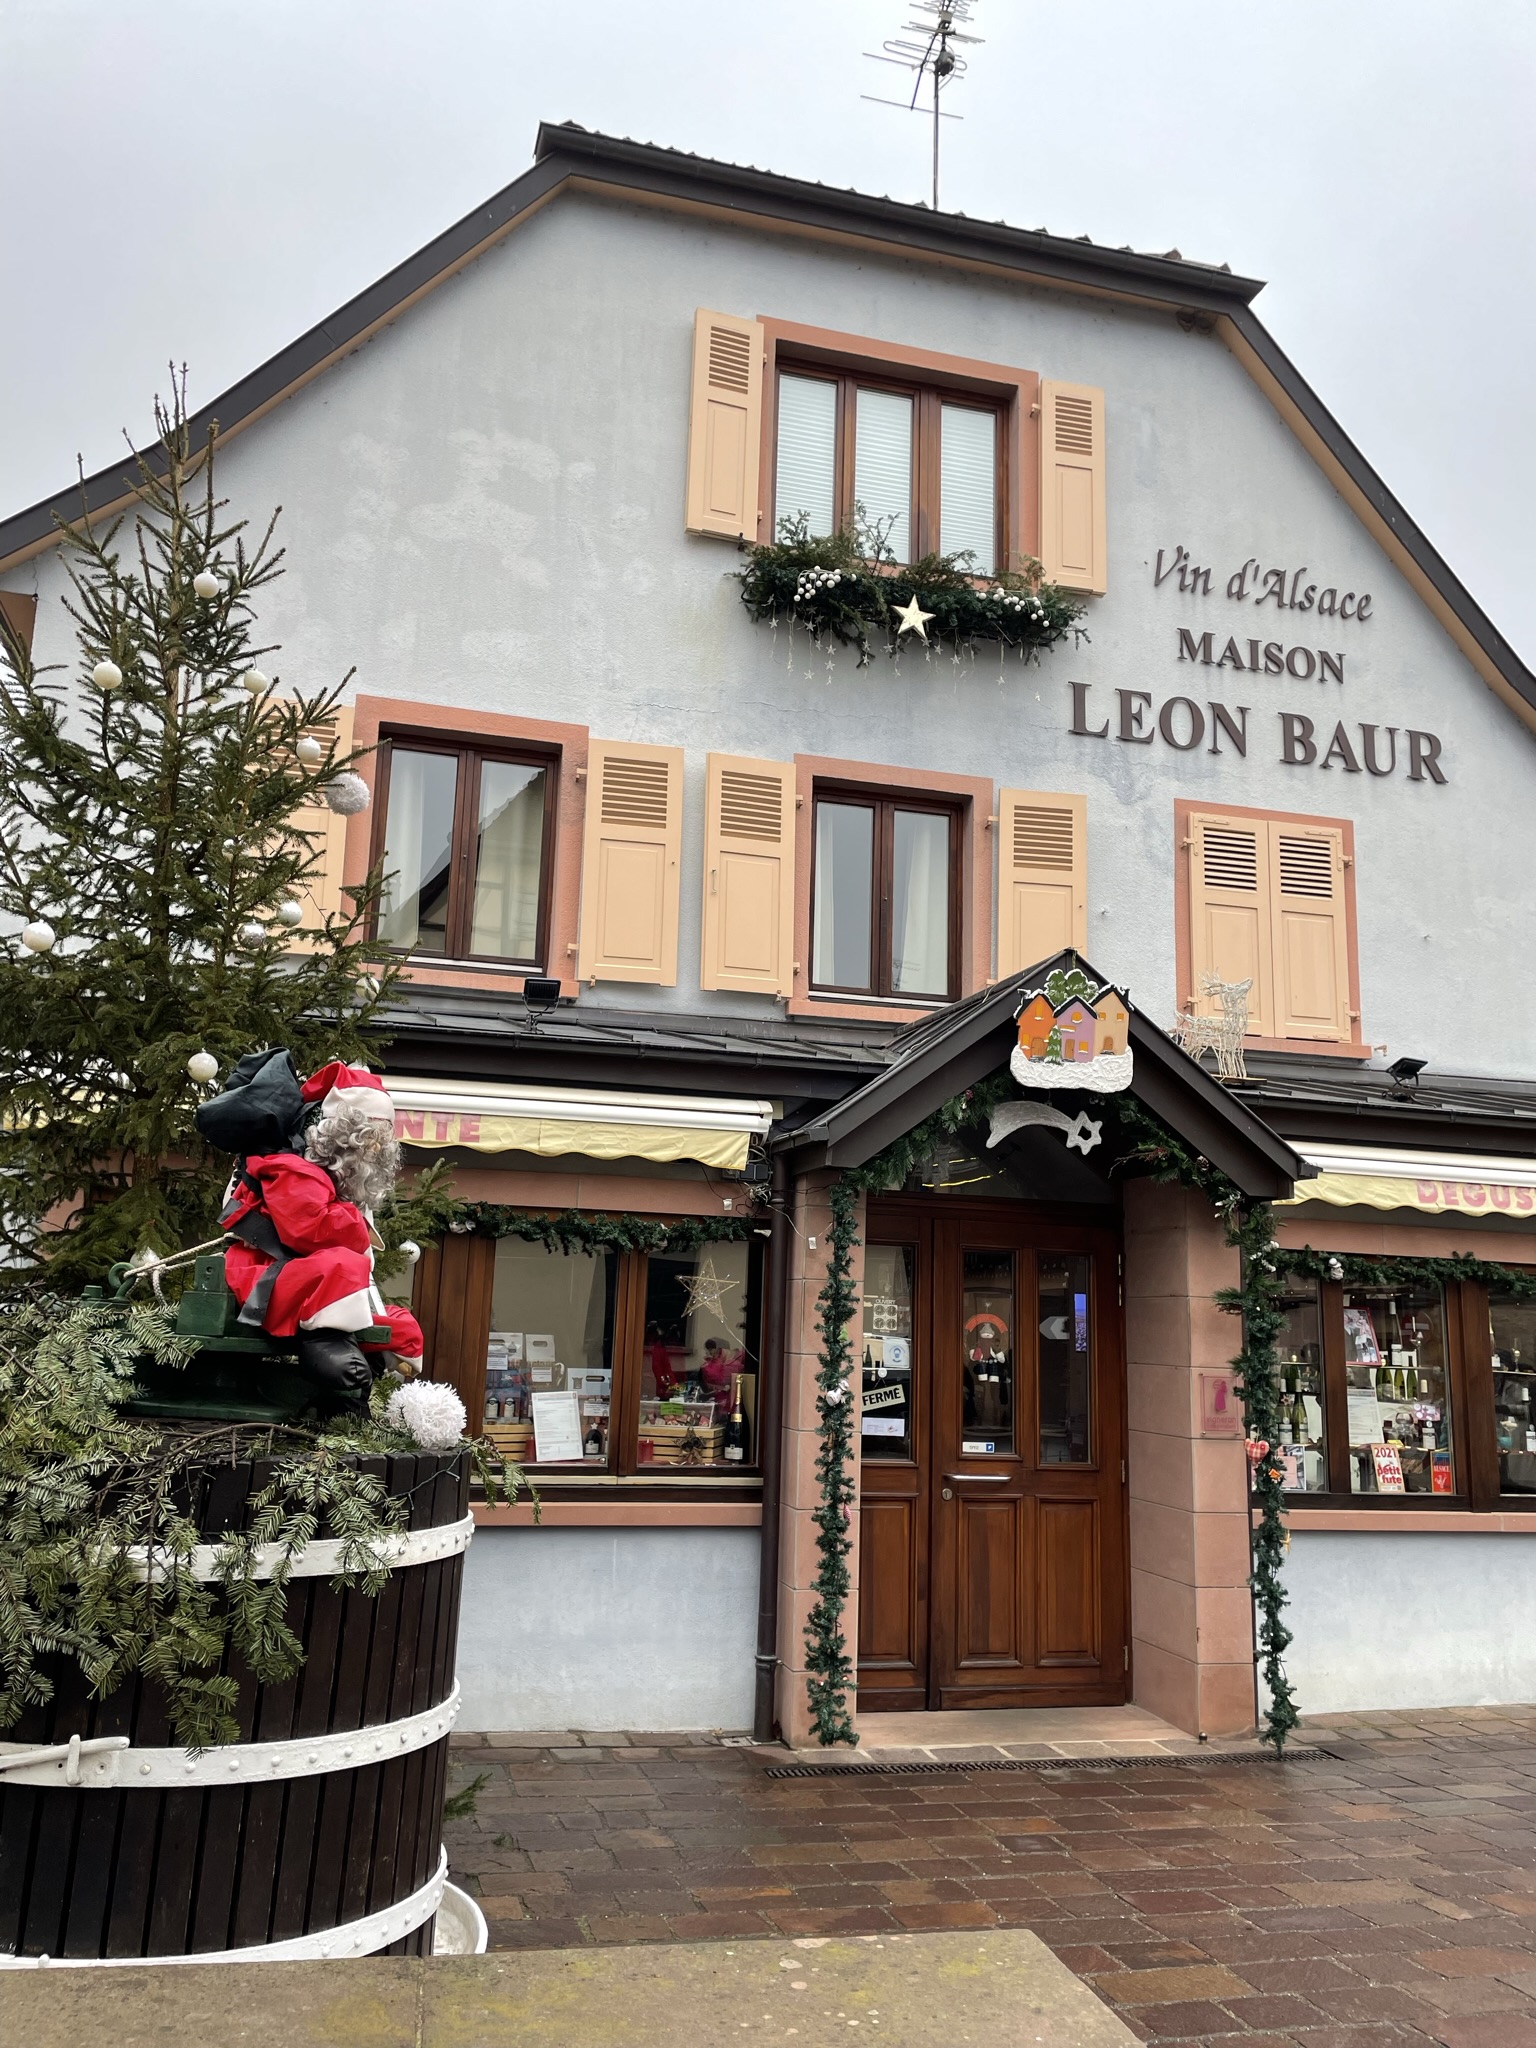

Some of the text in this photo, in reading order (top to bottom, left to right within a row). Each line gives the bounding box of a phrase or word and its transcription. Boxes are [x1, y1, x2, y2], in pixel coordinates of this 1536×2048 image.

[1153, 545, 1374, 621] Vin d'Alsace
[1176, 627, 1347, 684] MAISON
[1067, 681, 1449, 784] LEON BAUR
[1374, 1447, 1396, 1458] 2021
